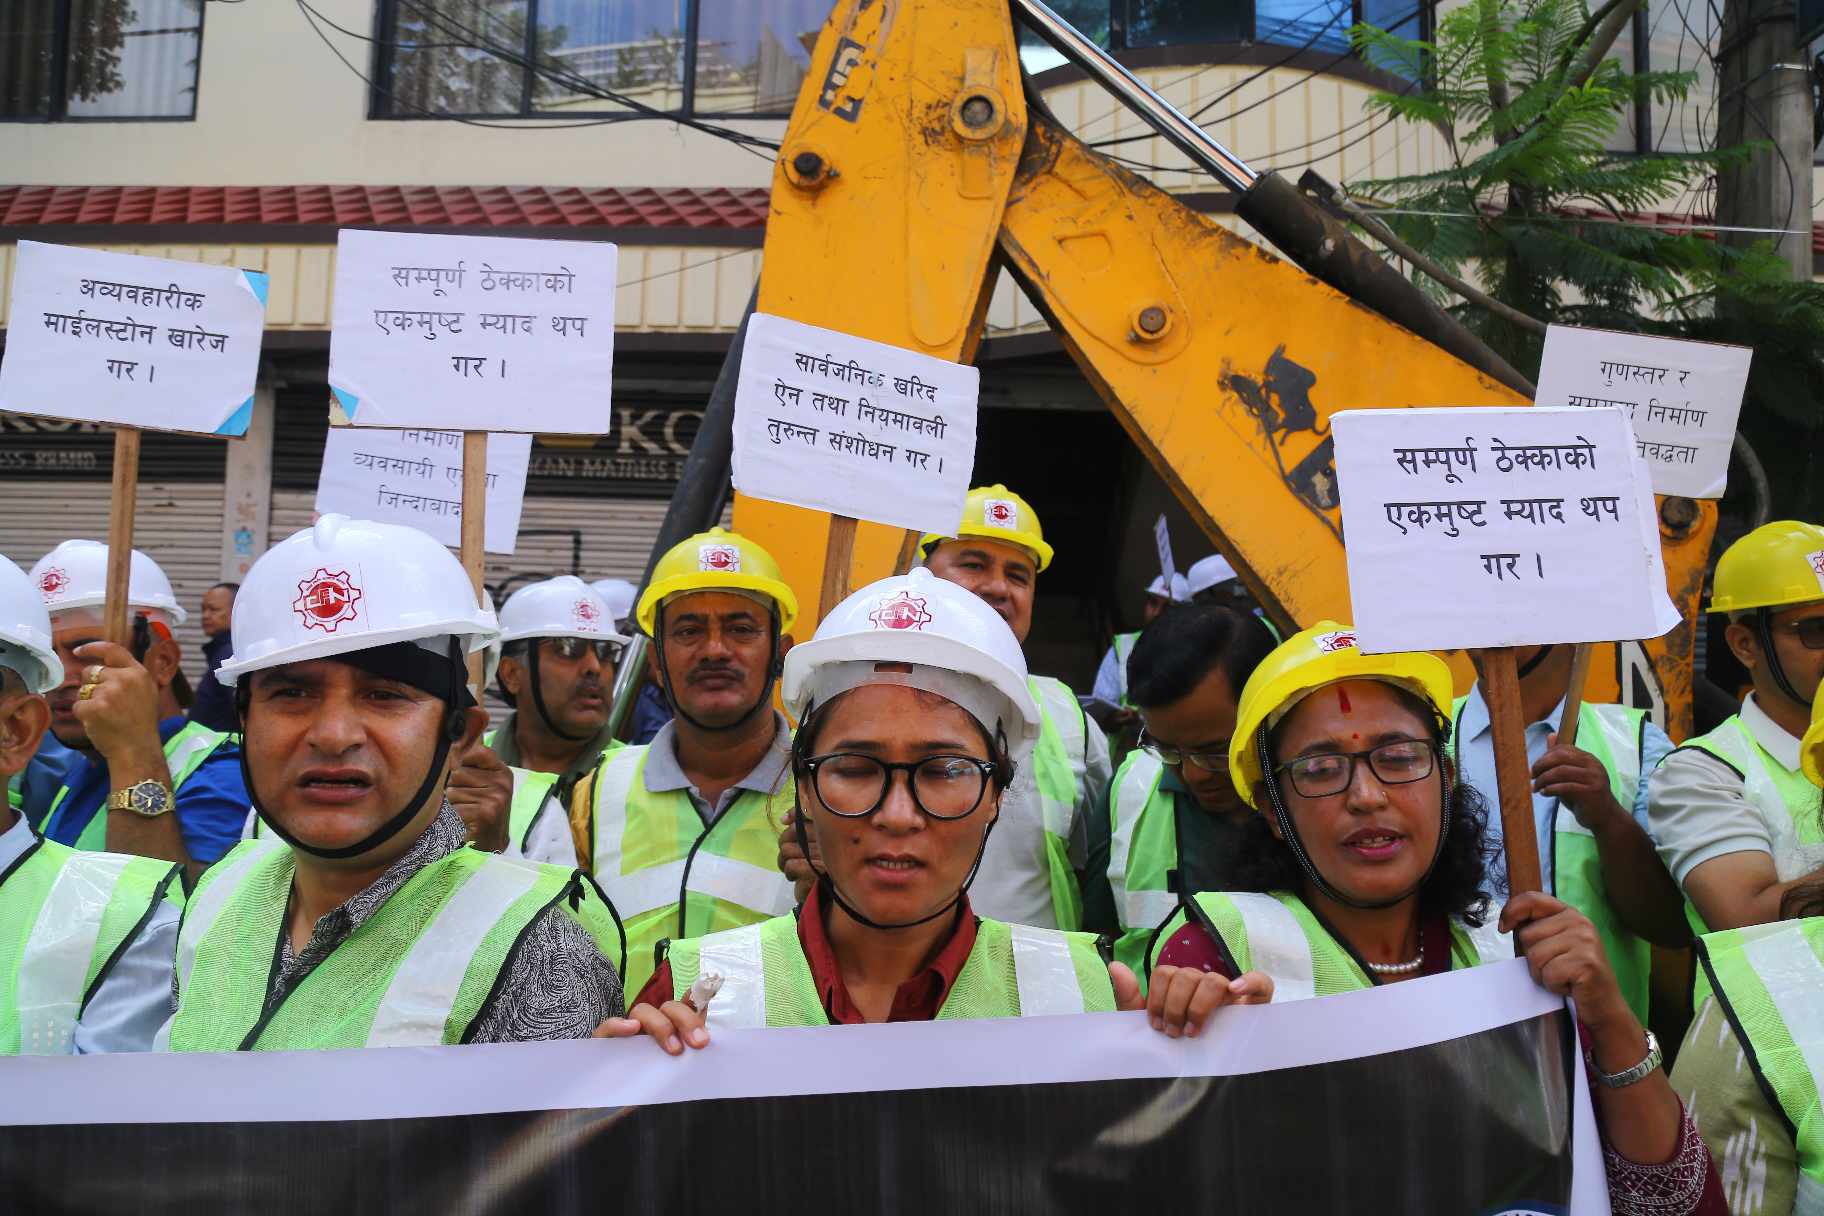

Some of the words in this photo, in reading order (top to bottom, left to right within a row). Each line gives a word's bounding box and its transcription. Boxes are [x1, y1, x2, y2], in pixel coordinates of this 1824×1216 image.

[79, 278, 206, 312] अव्यवहारीक
[391, 260, 467, 297] सम्पूर्ण
[479, 263, 576, 294] ठेक्काको
[43, 309, 158, 345] माईलस्टोन
[167, 325, 229, 353] खारेज
[373, 309, 465, 341] एकमुष्ट
[479, 313, 537, 336] म्याद
[551, 316, 589, 338] थप
[106, 358, 139, 381] गर
[451, 356, 487, 378] गर
[795, 352, 884, 388] सार्वजनिक
[893, 375, 939, 403] खरिद
[1599, 361, 1670, 387] गुणस्तर
[1679, 369, 1691, 387] र
[774, 377, 804, 407] ऐन
[811, 391, 850, 417] तथा
[857, 397, 948, 441] नियमावली
[1646, 398, 1709, 428] निर्माण
[767, 418, 820, 447] तुरुन्त
[828, 429, 897, 464] संशोधन
[905, 448, 931, 471] गर
[1393, 436, 1478, 484] सम्पूर्ण
[1490, 435, 1597, 473] ठेक्काको
[352, 453, 436, 480] व्यवसायी
[1383, 500, 1488, 538] एकमुष्ट
[1500, 498, 1567, 526] म्याद
[1580, 496, 1620, 523] थप
[1479, 553, 1521, 582] गर
